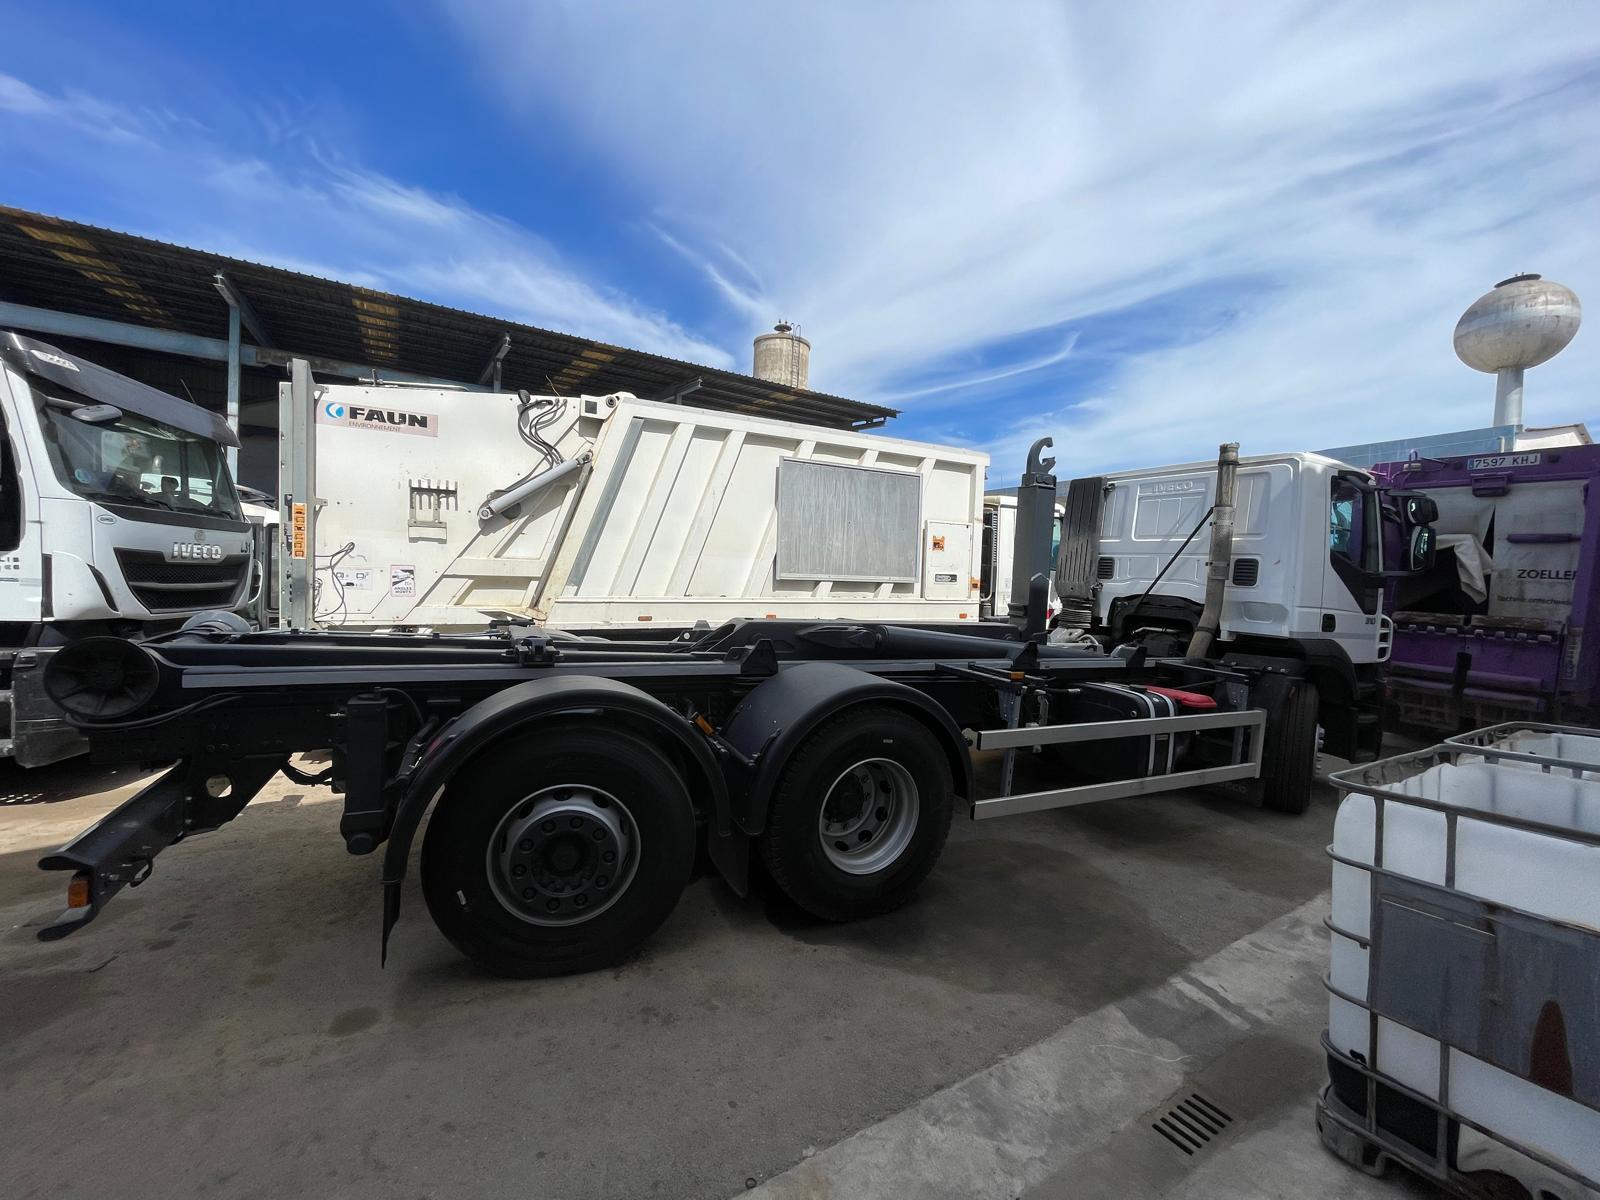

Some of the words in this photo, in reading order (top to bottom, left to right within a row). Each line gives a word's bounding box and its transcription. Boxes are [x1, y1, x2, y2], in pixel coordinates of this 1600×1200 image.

[349, 407, 427, 428] FAUN
[349, 421, 401, 433] ENVIRONNEMENT
[1475, 458, 1506, 469] 7597
[1512, 455, 1539, 466] KHJ
[171, 541, 223, 560] IVECO
